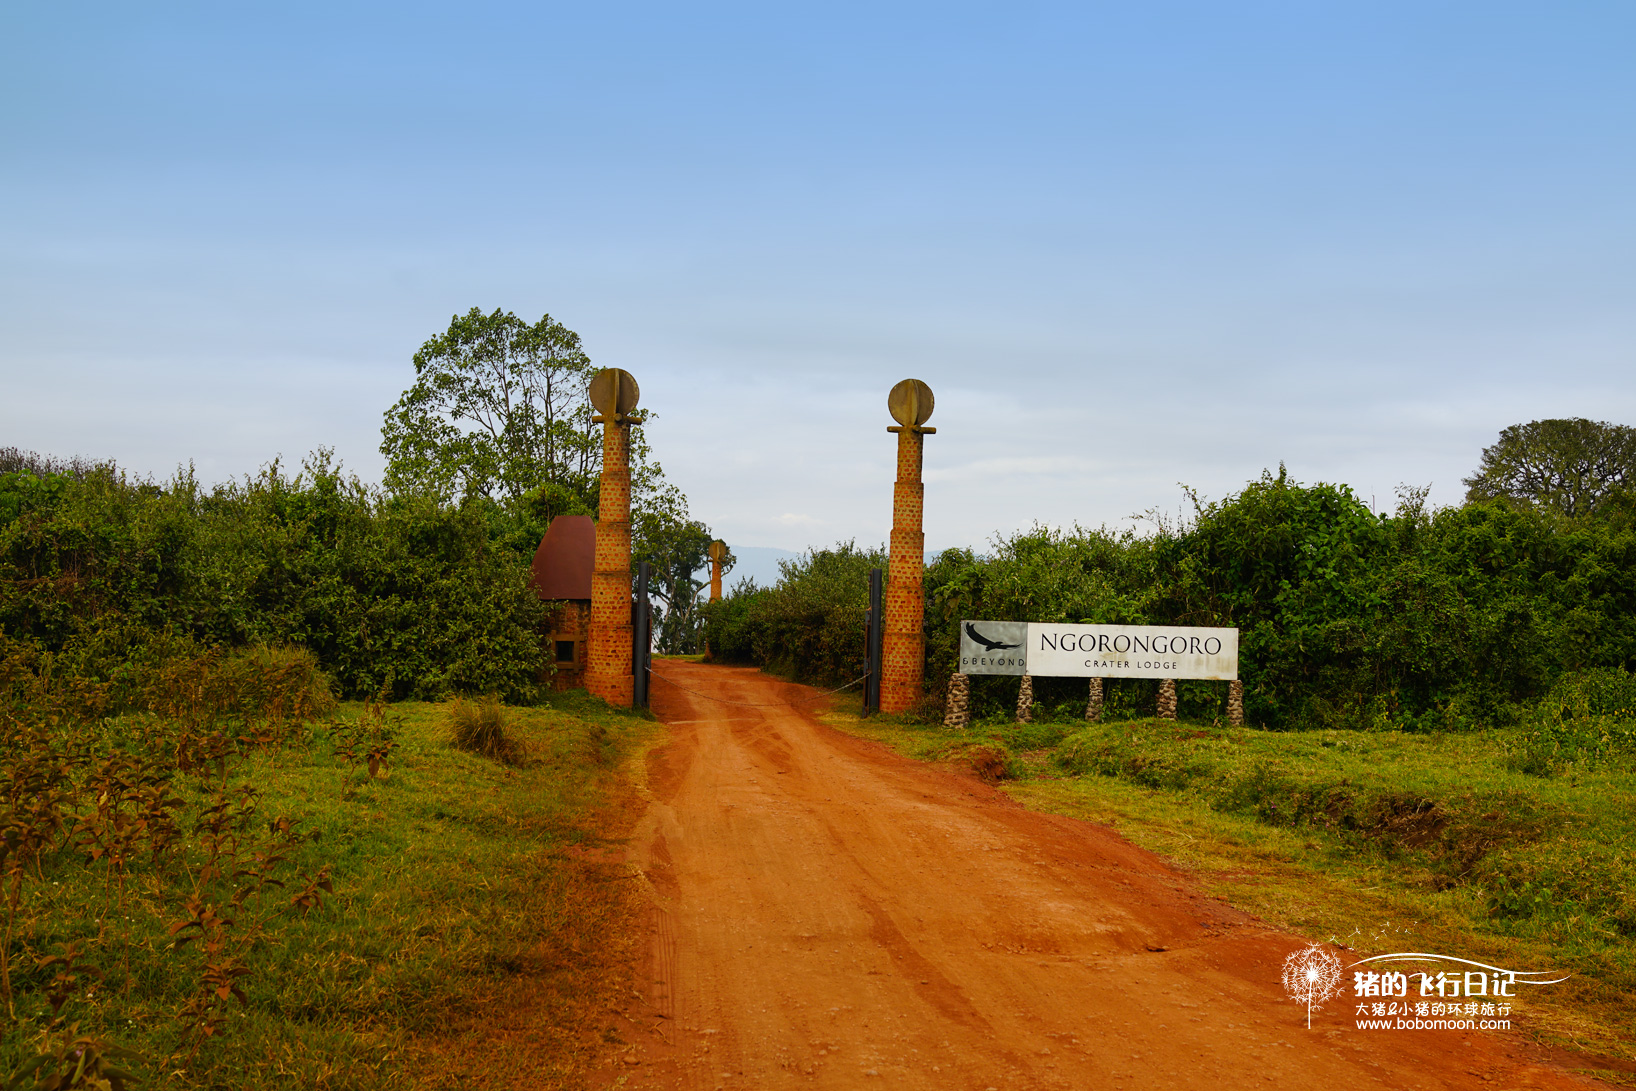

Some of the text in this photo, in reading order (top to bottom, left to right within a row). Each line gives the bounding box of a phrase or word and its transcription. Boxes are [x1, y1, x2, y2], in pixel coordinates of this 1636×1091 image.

[1041, 633, 1222, 655] NGORONGORO
[1084, 660, 1177, 670] CRATER LODGE
